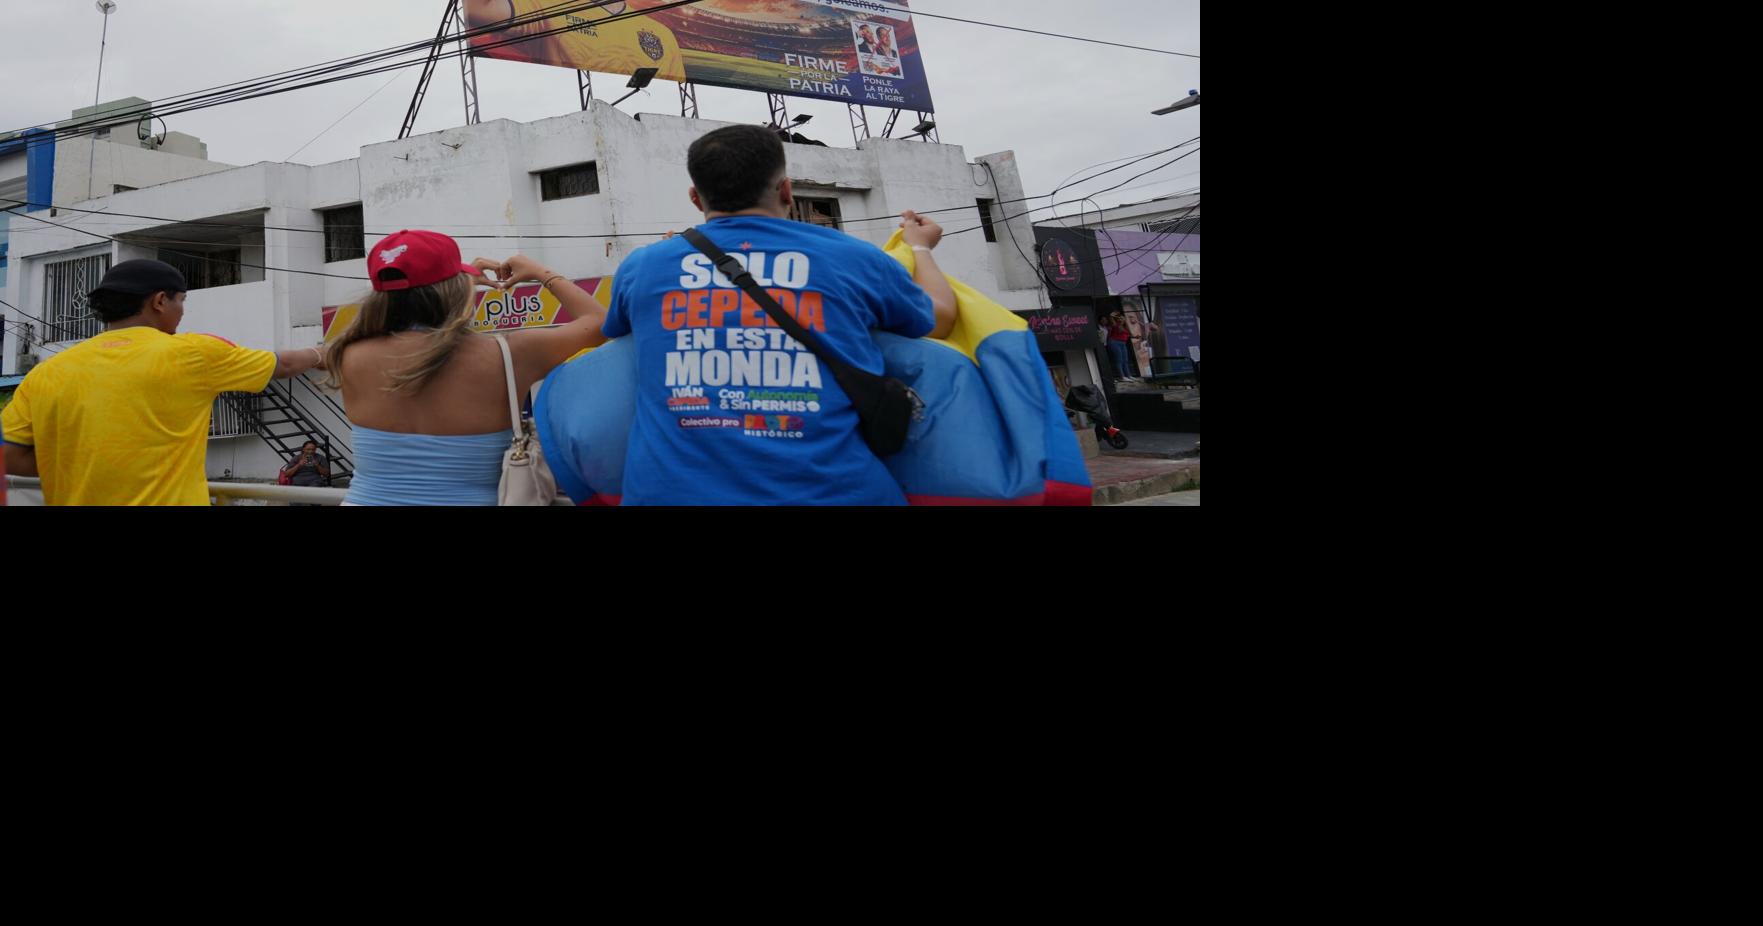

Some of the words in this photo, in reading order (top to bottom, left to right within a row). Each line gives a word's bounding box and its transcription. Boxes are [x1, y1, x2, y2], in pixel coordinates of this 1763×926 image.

[566, 14, 593, 25] FIRM
[784, 53, 849, 74] FIRME
[801, 71, 824, 79] POR
[826, 73, 837, 81] LA
[862, 76, 893, 87] PONLE
[790, 78, 852, 97] PATRIA
[864, 84, 876, 92] LA
[877, 86, 900, 95] RAYA
[866, 92, 878, 100] AL
[879, 93, 905, 103] TIGRE
[679, 251, 810, 289] SOLO
[486, 293, 541, 321] plus
[661, 288, 826, 333] CEPEDA
[474, 315, 544, 327] ROGUERIA
[676, 329, 715, 350] EN
[726, 328, 808, 351] ESTA
[665, 350, 823, 389] MONDA
[672, 385, 704, 398] IVÁN
[718, 389, 745, 400] Con
[719, 399, 730, 410] &
[731, 399, 750, 410] Sin
[680, 417, 720, 427] Colectivo
[722, 418, 740, 428] pro
